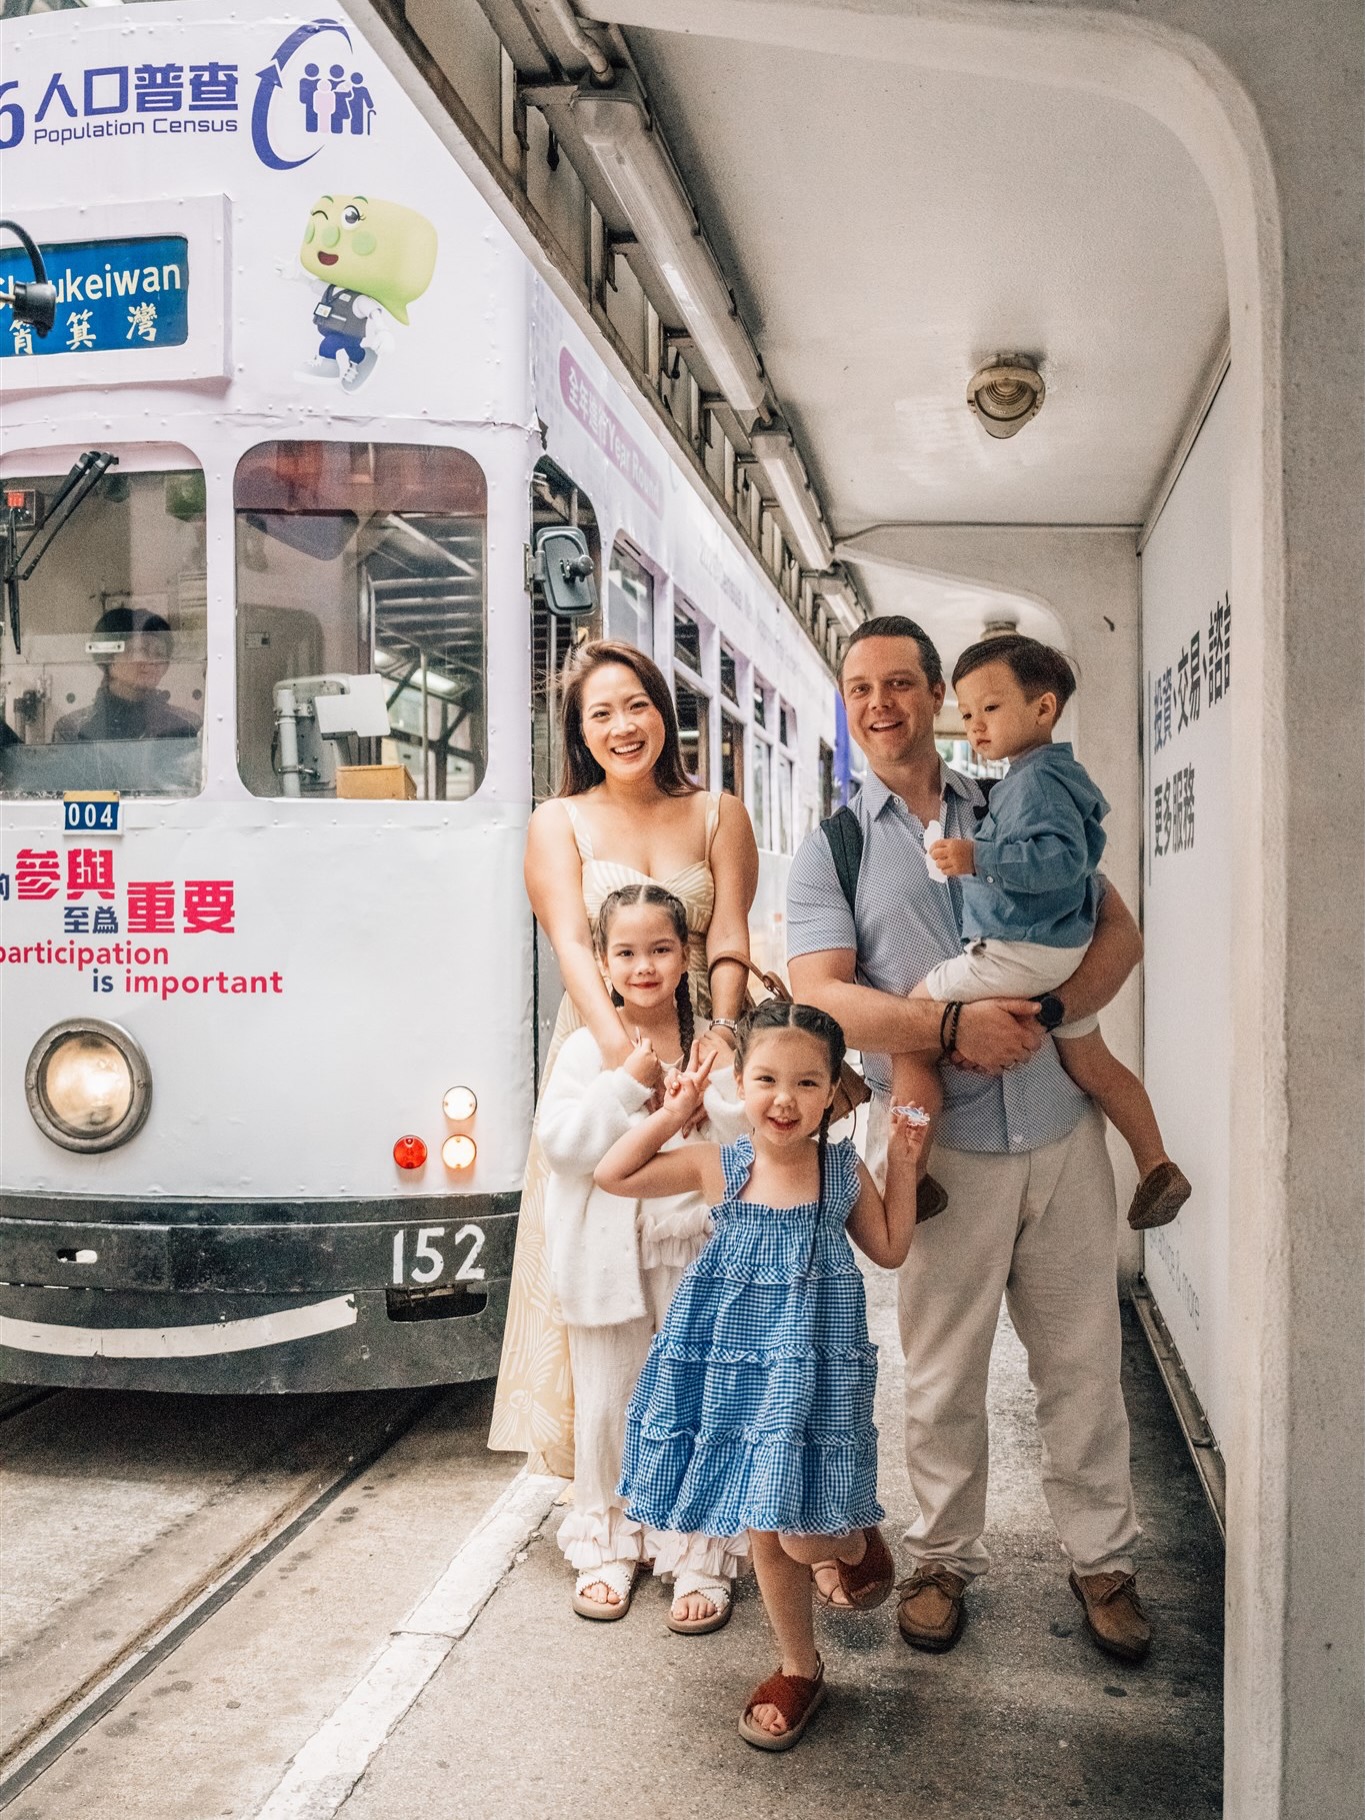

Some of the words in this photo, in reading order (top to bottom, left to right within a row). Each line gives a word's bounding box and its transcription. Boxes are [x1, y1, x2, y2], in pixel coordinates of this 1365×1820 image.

[34, 62, 239, 123] 人口普查
[34, 119, 146, 146] Population
[152, 117, 239, 134] Census
[68, 802, 113, 828] 004
[92, 967, 114, 993] is
[125, 967, 284, 1001] important
[392, 1223, 486, 1285] 152
